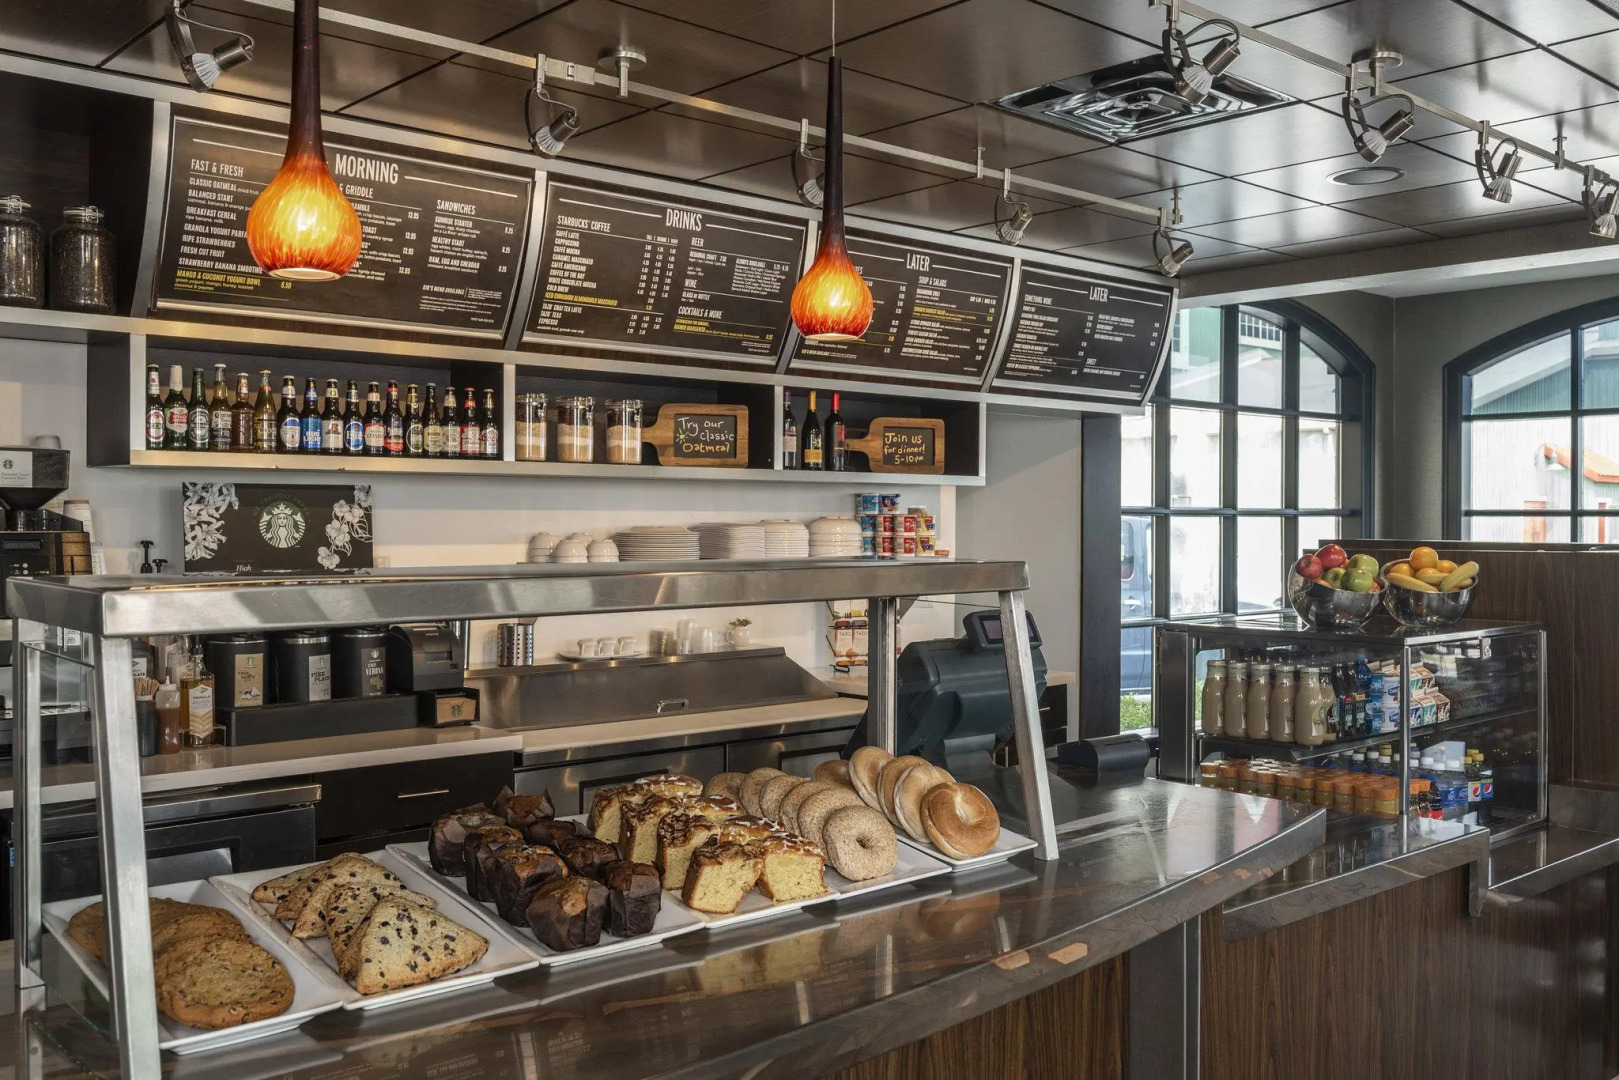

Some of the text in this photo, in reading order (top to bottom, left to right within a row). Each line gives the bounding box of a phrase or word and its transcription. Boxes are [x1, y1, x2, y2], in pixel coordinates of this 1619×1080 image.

[191, 159, 244, 177] FAST & FRESH
[335, 154, 399, 184] MORNING
[189, 177, 212, 188] CLASSIC
[213, 181, 236, 191] OATMEAL
[345, 184, 373, 198] GRIDDLE
[188, 189, 233, 202] BALANCED START
[186, 206, 237, 220] BREAKFAST CEREAL
[437, 200, 475, 215] SANDWICHES
[591, 221, 611, 232] COFFEE
[666, 208, 702, 232] DRINKS
[184, 223, 247, 238] GRANOLA YOGURT PARFA
[363, 225, 377, 234] TOAST
[182, 234, 235, 248] RIPE STRAWBERRIES
[691, 237, 704, 247] BEER
[180, 246, 225, 258] FRESH CUT FRUIT
[179, 258, 214, 268] STRAWBERRY
[214, 262, 236, 271] BANANA
[906, 253, 930, 272] LATER
[1090, 286, 1108, 302] LATER
[678, 306, 704, 317] COCKTAILS
[677, 417, 724, 437] Try our
[700, 429, 734, 441] classic
[885, 432, 922, 444] Join us
[884, 443, 925, 455] for dinner!
